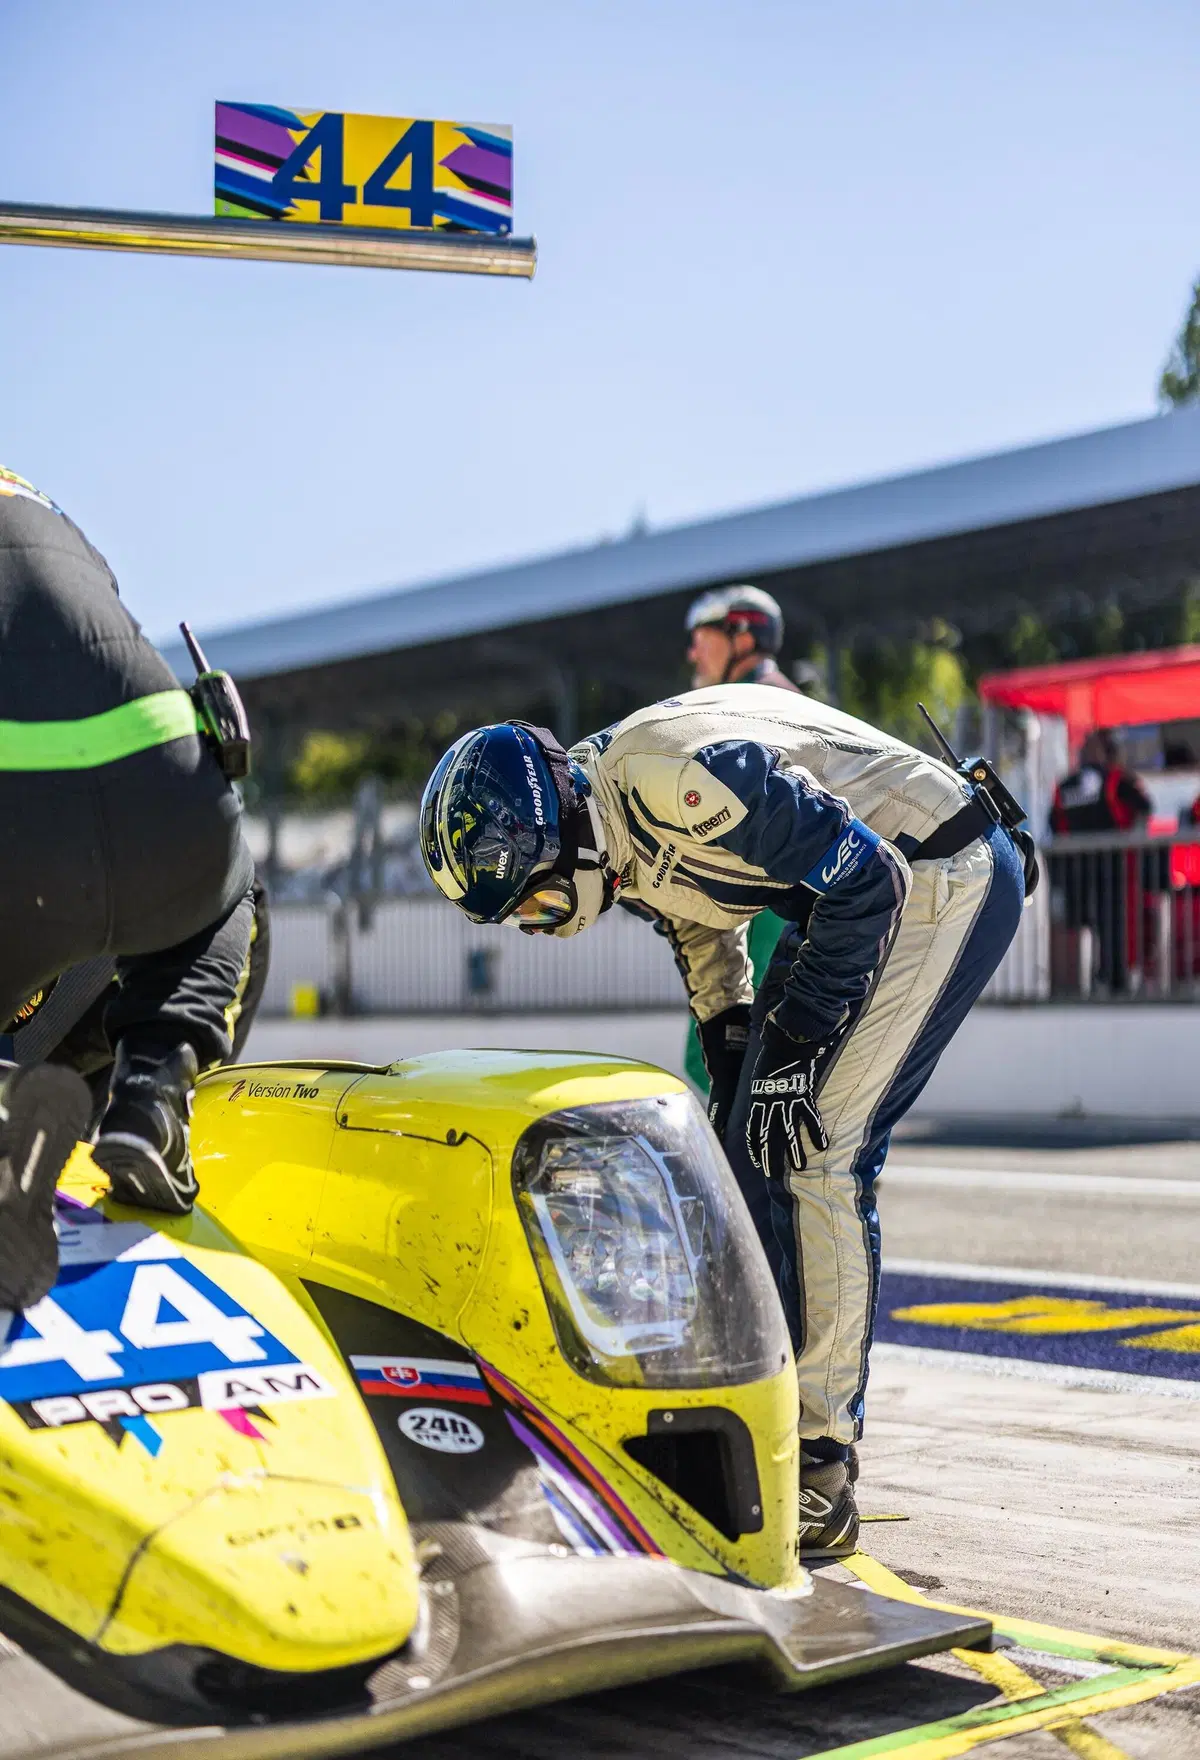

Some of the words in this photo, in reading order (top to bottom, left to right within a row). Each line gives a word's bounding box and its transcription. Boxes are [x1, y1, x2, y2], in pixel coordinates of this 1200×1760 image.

[272, 112, 448, 228] 44
[523, 755, 544, 826] GOODYEAR
[691, 806, 732, 838] freem
[495, 850, 510, 880] uvex
[821, 829, 860, 884] WEC
[248, 1082, 291, 1099] Version
[292, 1084, 320, 1099] Two
[0, 1263, 269, 1383] 44
[31, 1383, 190, 1427] PRO
[223, 1373, 322, 1398] AM
[408, 1414, 471, 1435] 24h
